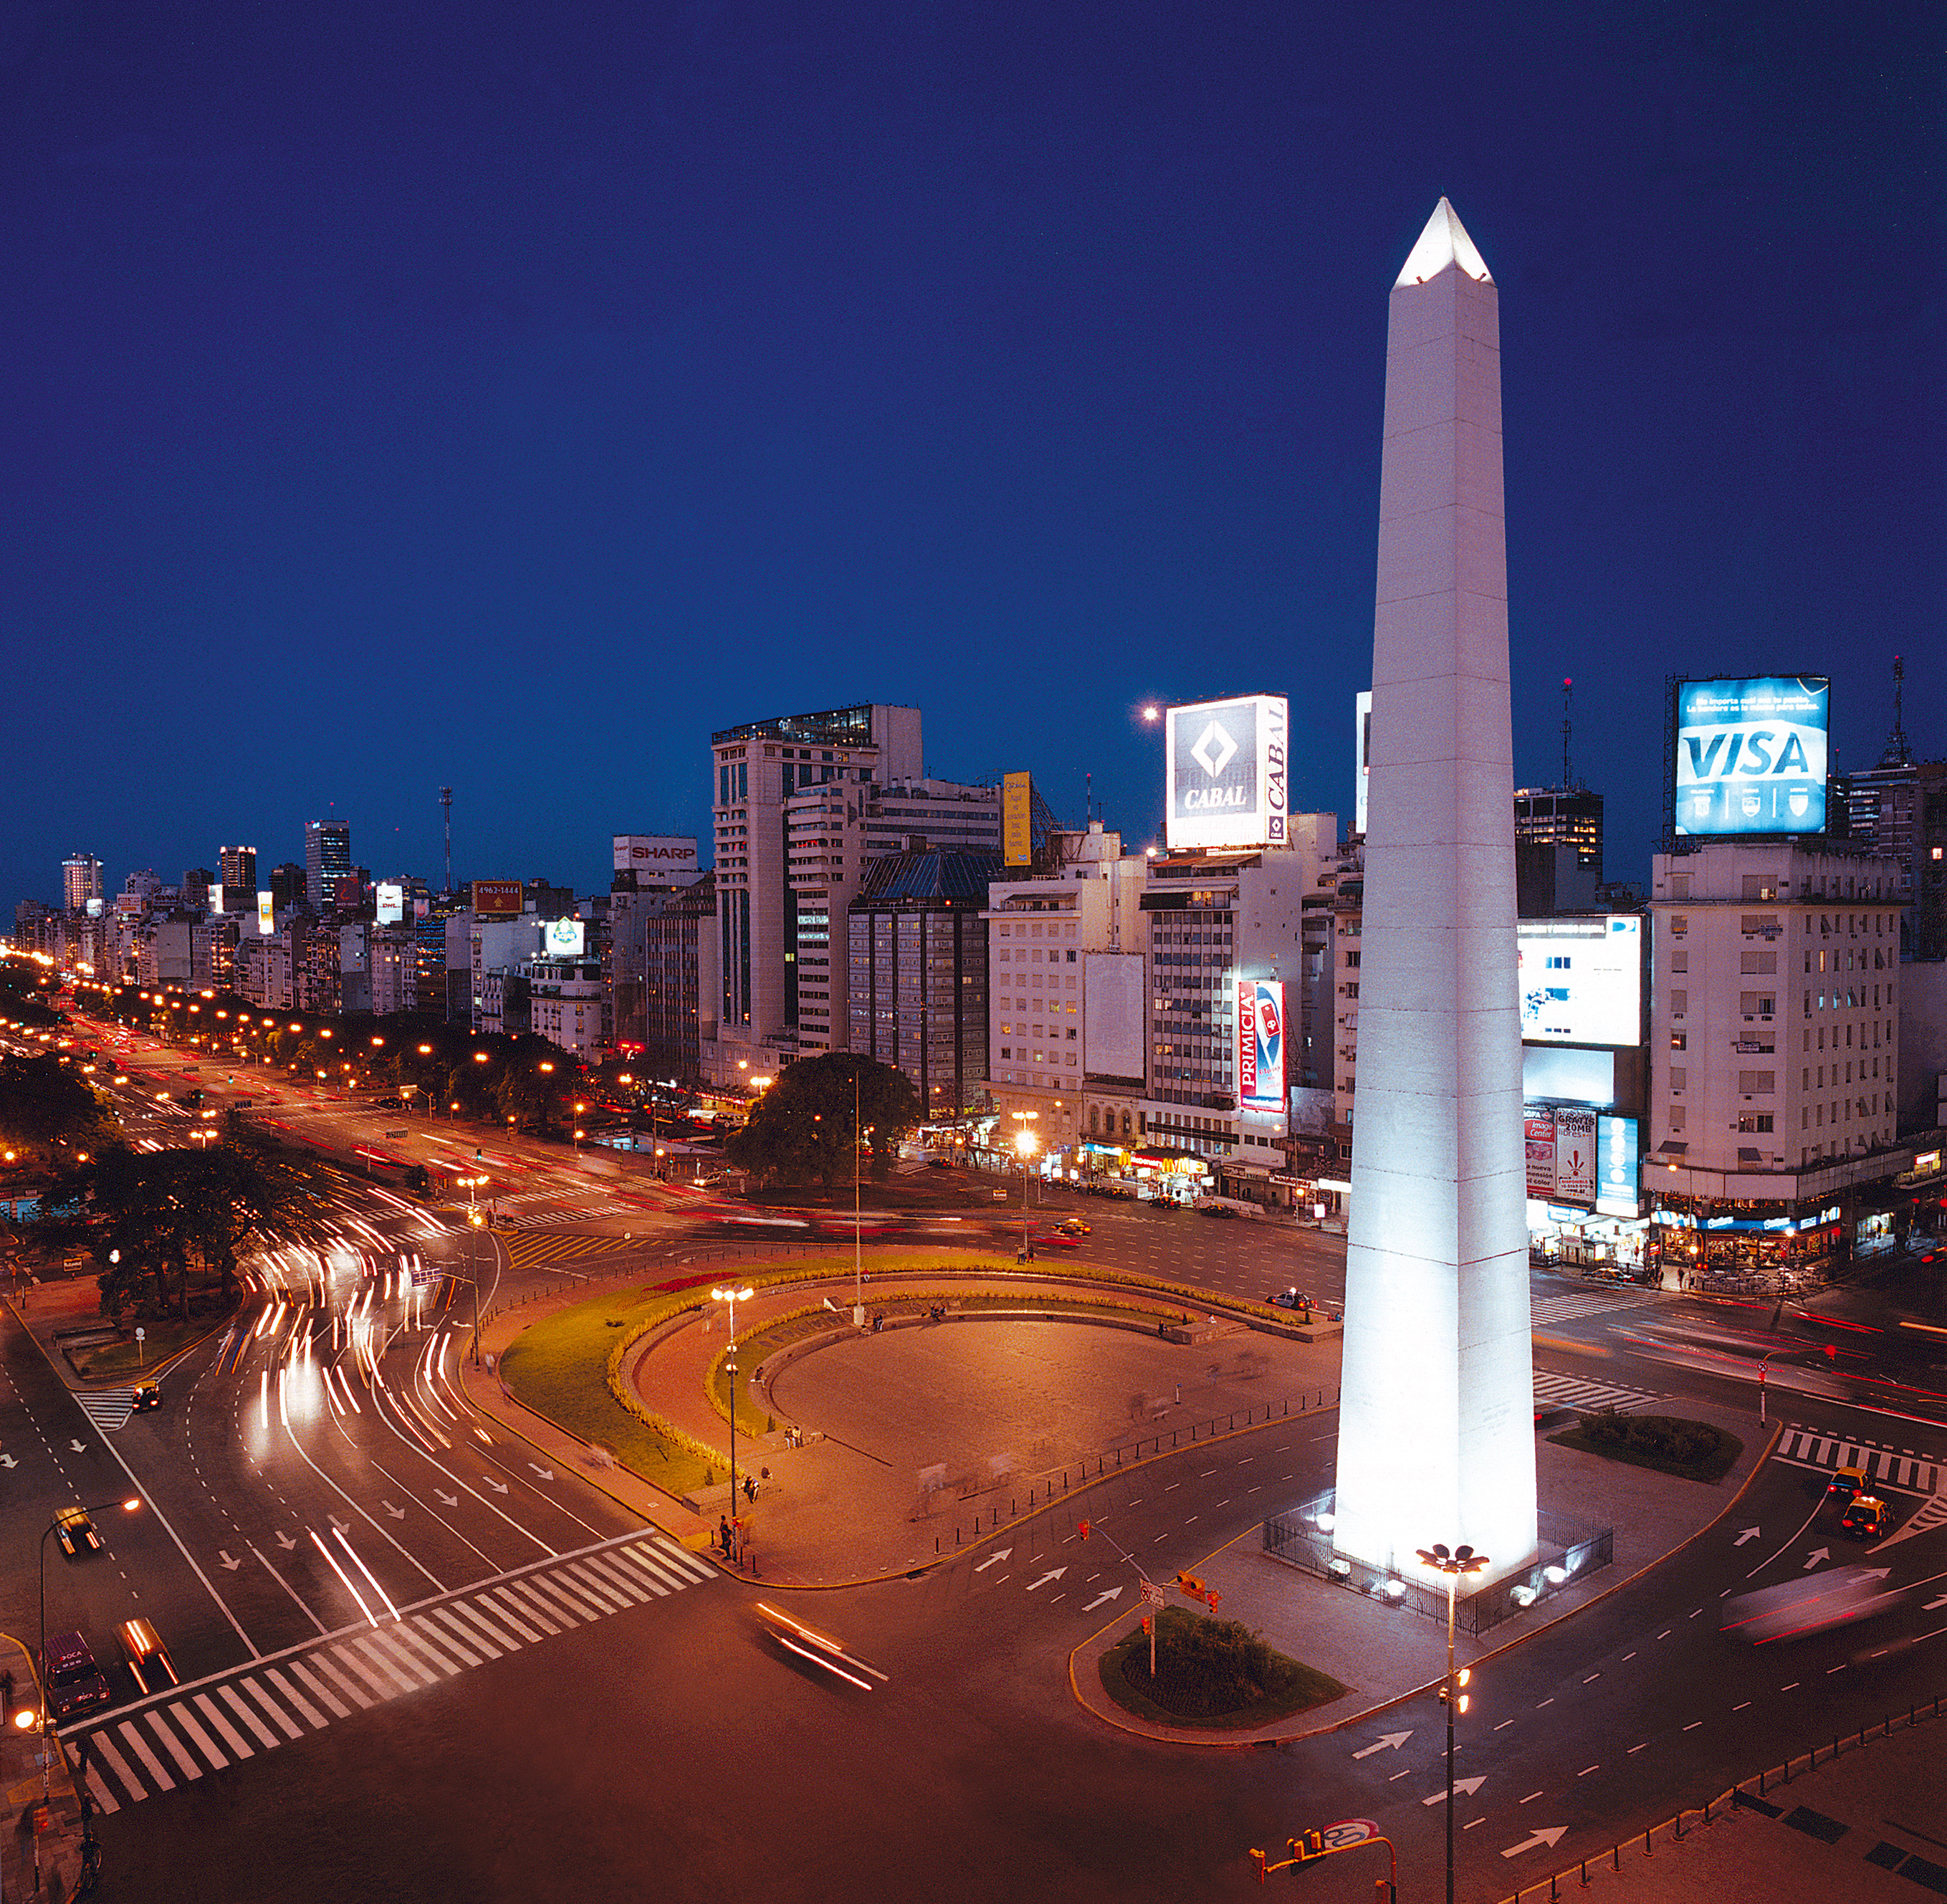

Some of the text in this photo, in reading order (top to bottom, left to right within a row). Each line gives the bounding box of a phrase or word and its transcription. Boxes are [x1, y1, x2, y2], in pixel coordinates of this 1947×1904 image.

[1268, 702, 1285, 811] CABAL
[1683, 731, 1809, 779] VISA
[1185, 785, 1247, 810] CABAL
[632, 846, 695, 860] SHARP
[1241, 995, 1255, 1086] PRIMICIA
[1532, 1121, 1553, 1131] Image
[1559, 1115, 1595, 1125] GRATIS
[1565, 1123, 1591, 1132] 20MB
[67, 1650, 82, 1659] OCA
[1324, 1825, 1366, 1847] 60
